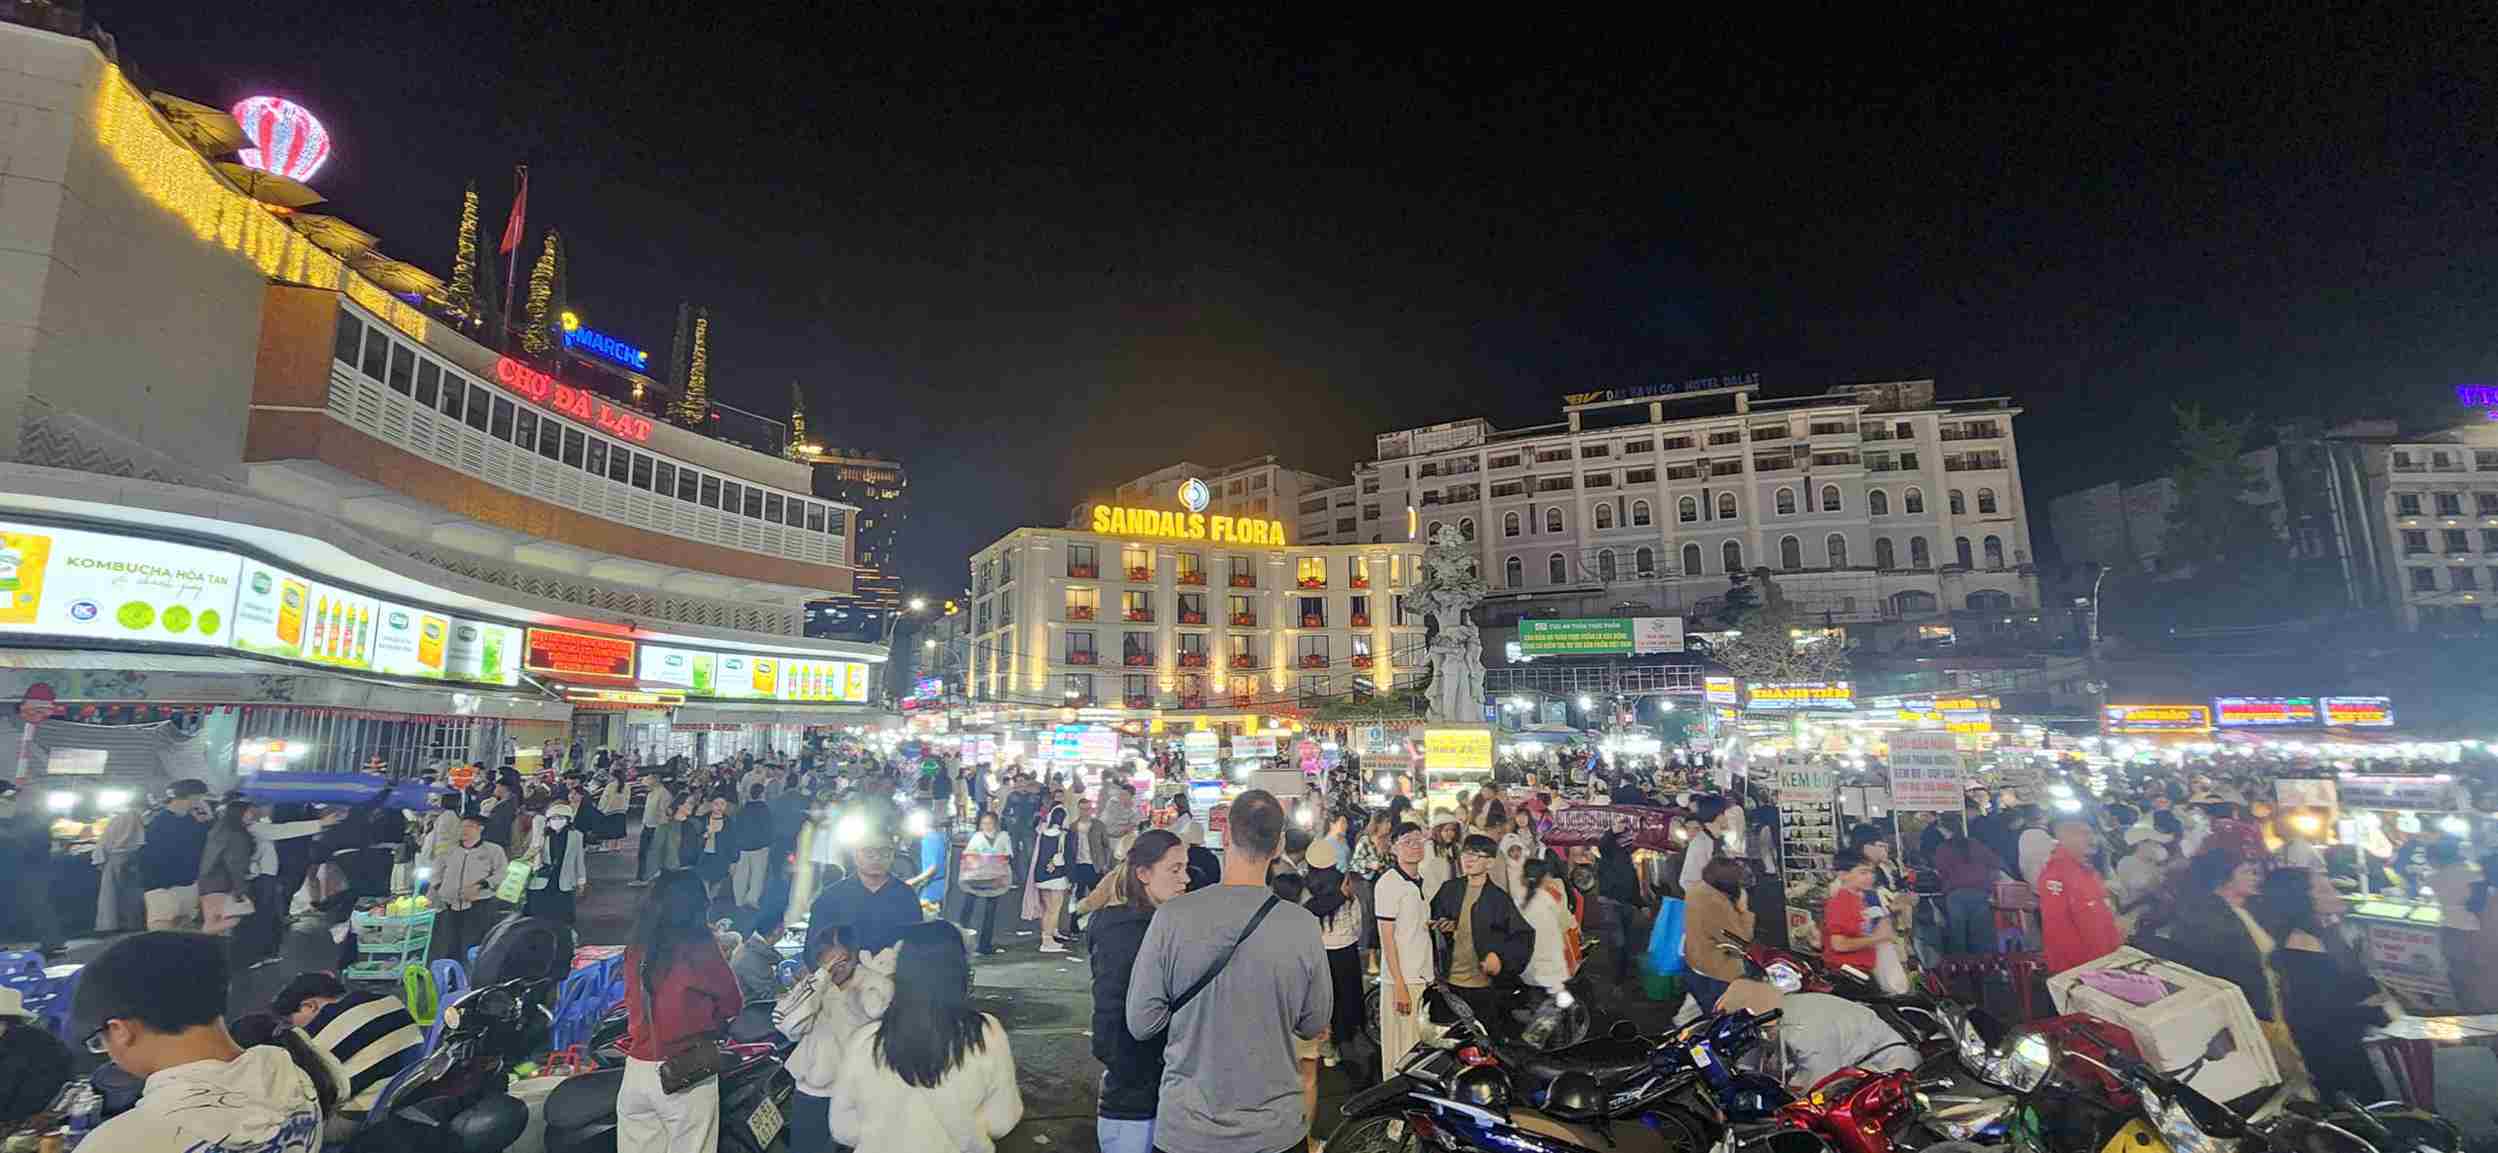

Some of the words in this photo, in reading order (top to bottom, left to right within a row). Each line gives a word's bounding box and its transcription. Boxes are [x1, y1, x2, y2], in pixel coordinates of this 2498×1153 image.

[496, 357, 553, 400] CHỢ
[553, 382, 593, 419] ĐÀ
[596, 404, 653, 442] LẠT
[1093, 505, 1206, 539] SANDALS
[1211, 516, 1286, 546] FLORA
[66, 556, 171, 578] KOMBUCHA
[208, 574, 229, 586] TAN
